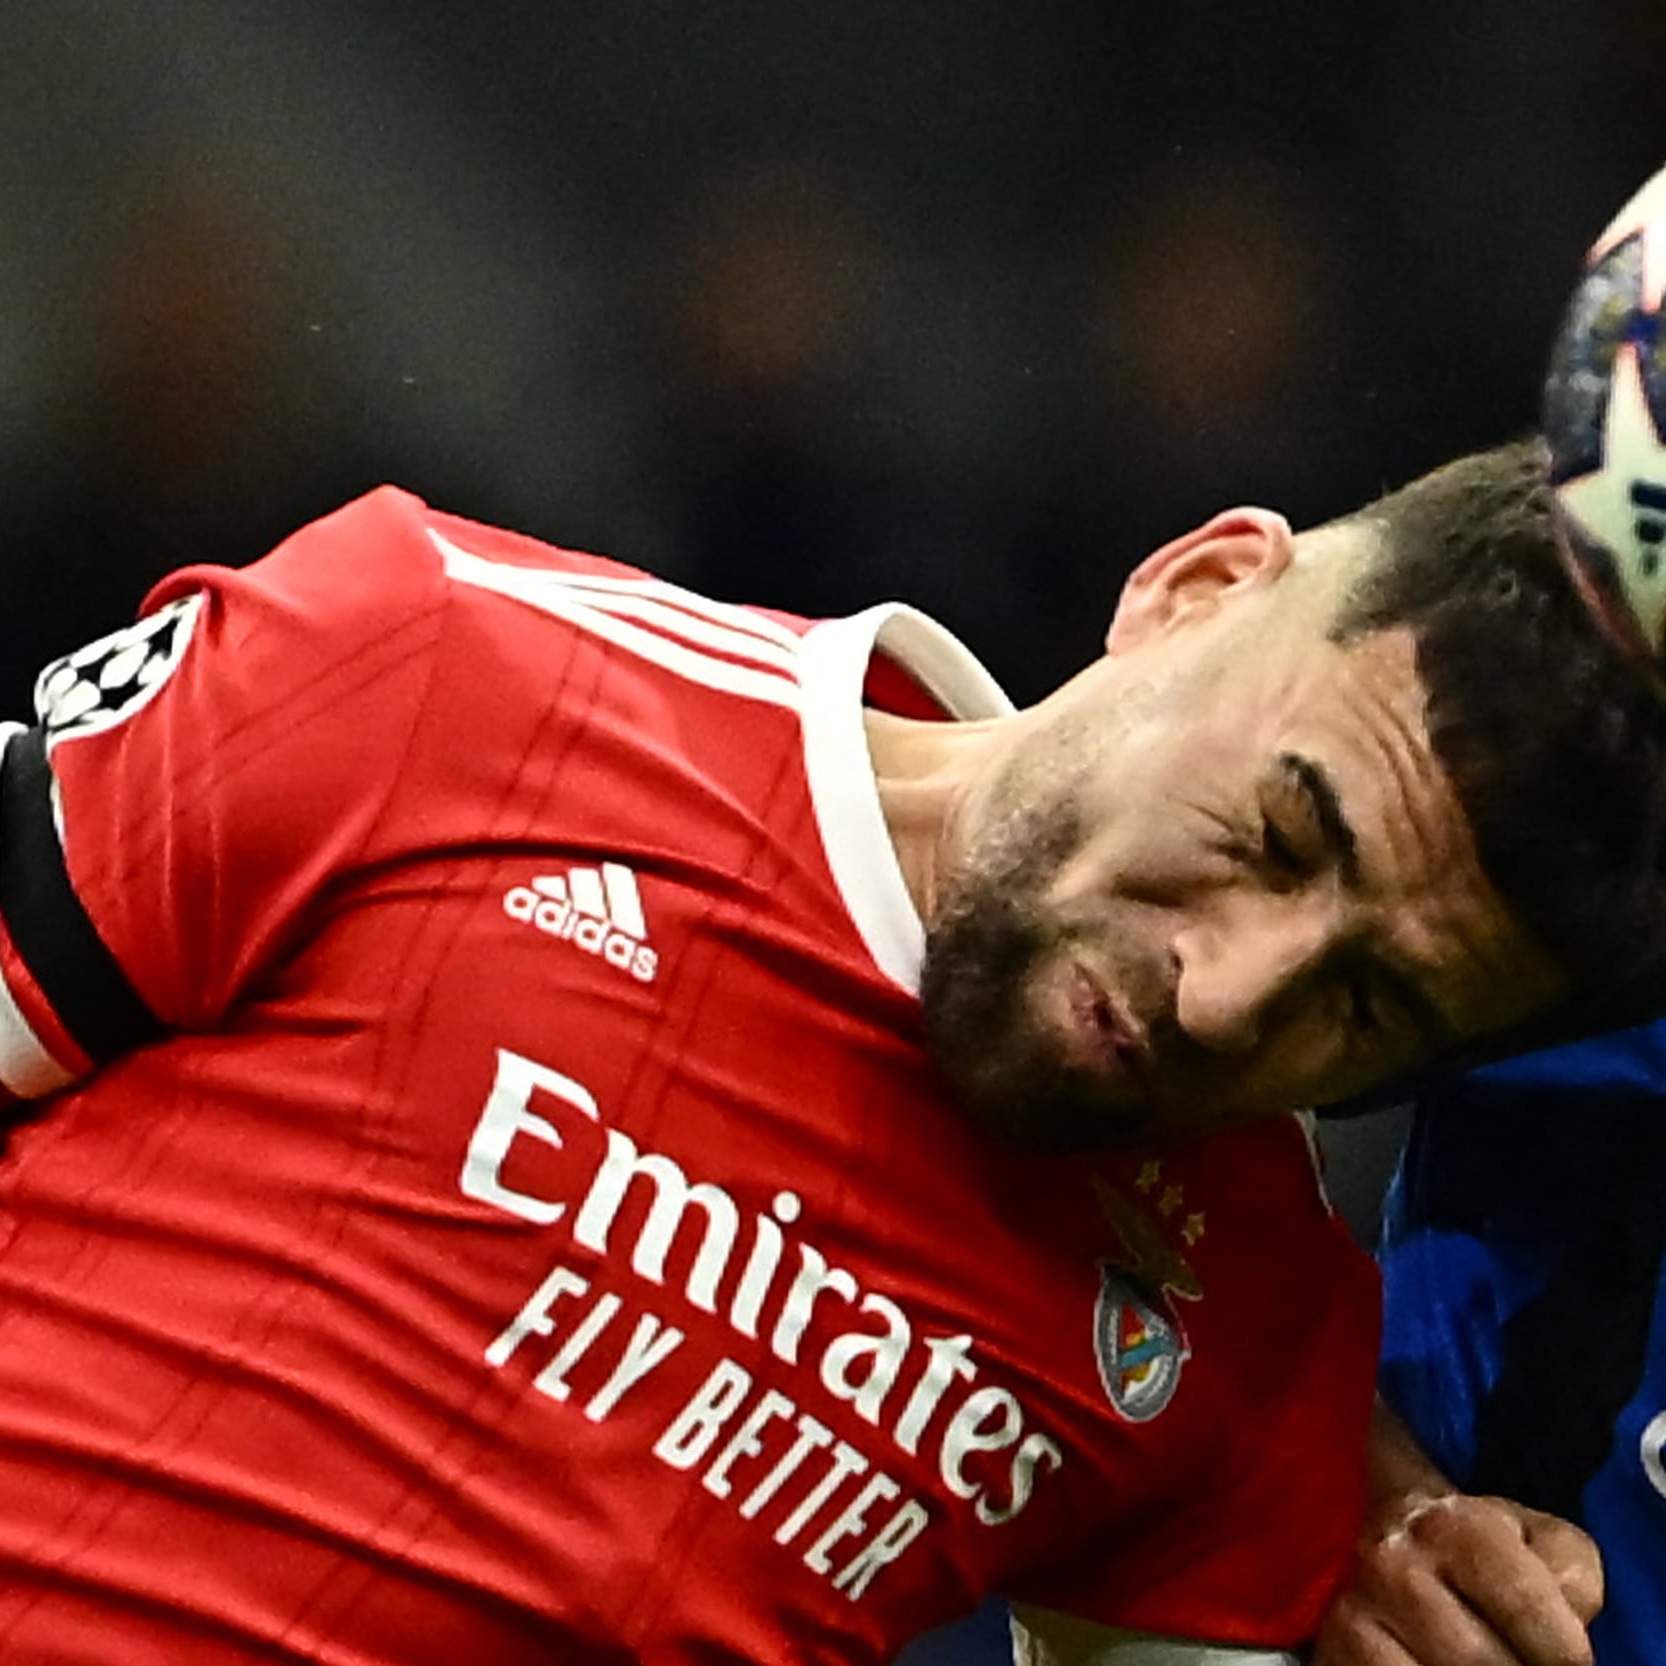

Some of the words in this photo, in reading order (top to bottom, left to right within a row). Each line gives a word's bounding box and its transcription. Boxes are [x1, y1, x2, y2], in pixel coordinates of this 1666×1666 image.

[503, 886, 659, 982] adidas
[458, 1048, 1063, 1526] Emirates
[484, 1266, 685, 1423] FLY
[653, 1358, 930, 1602] BETTER
